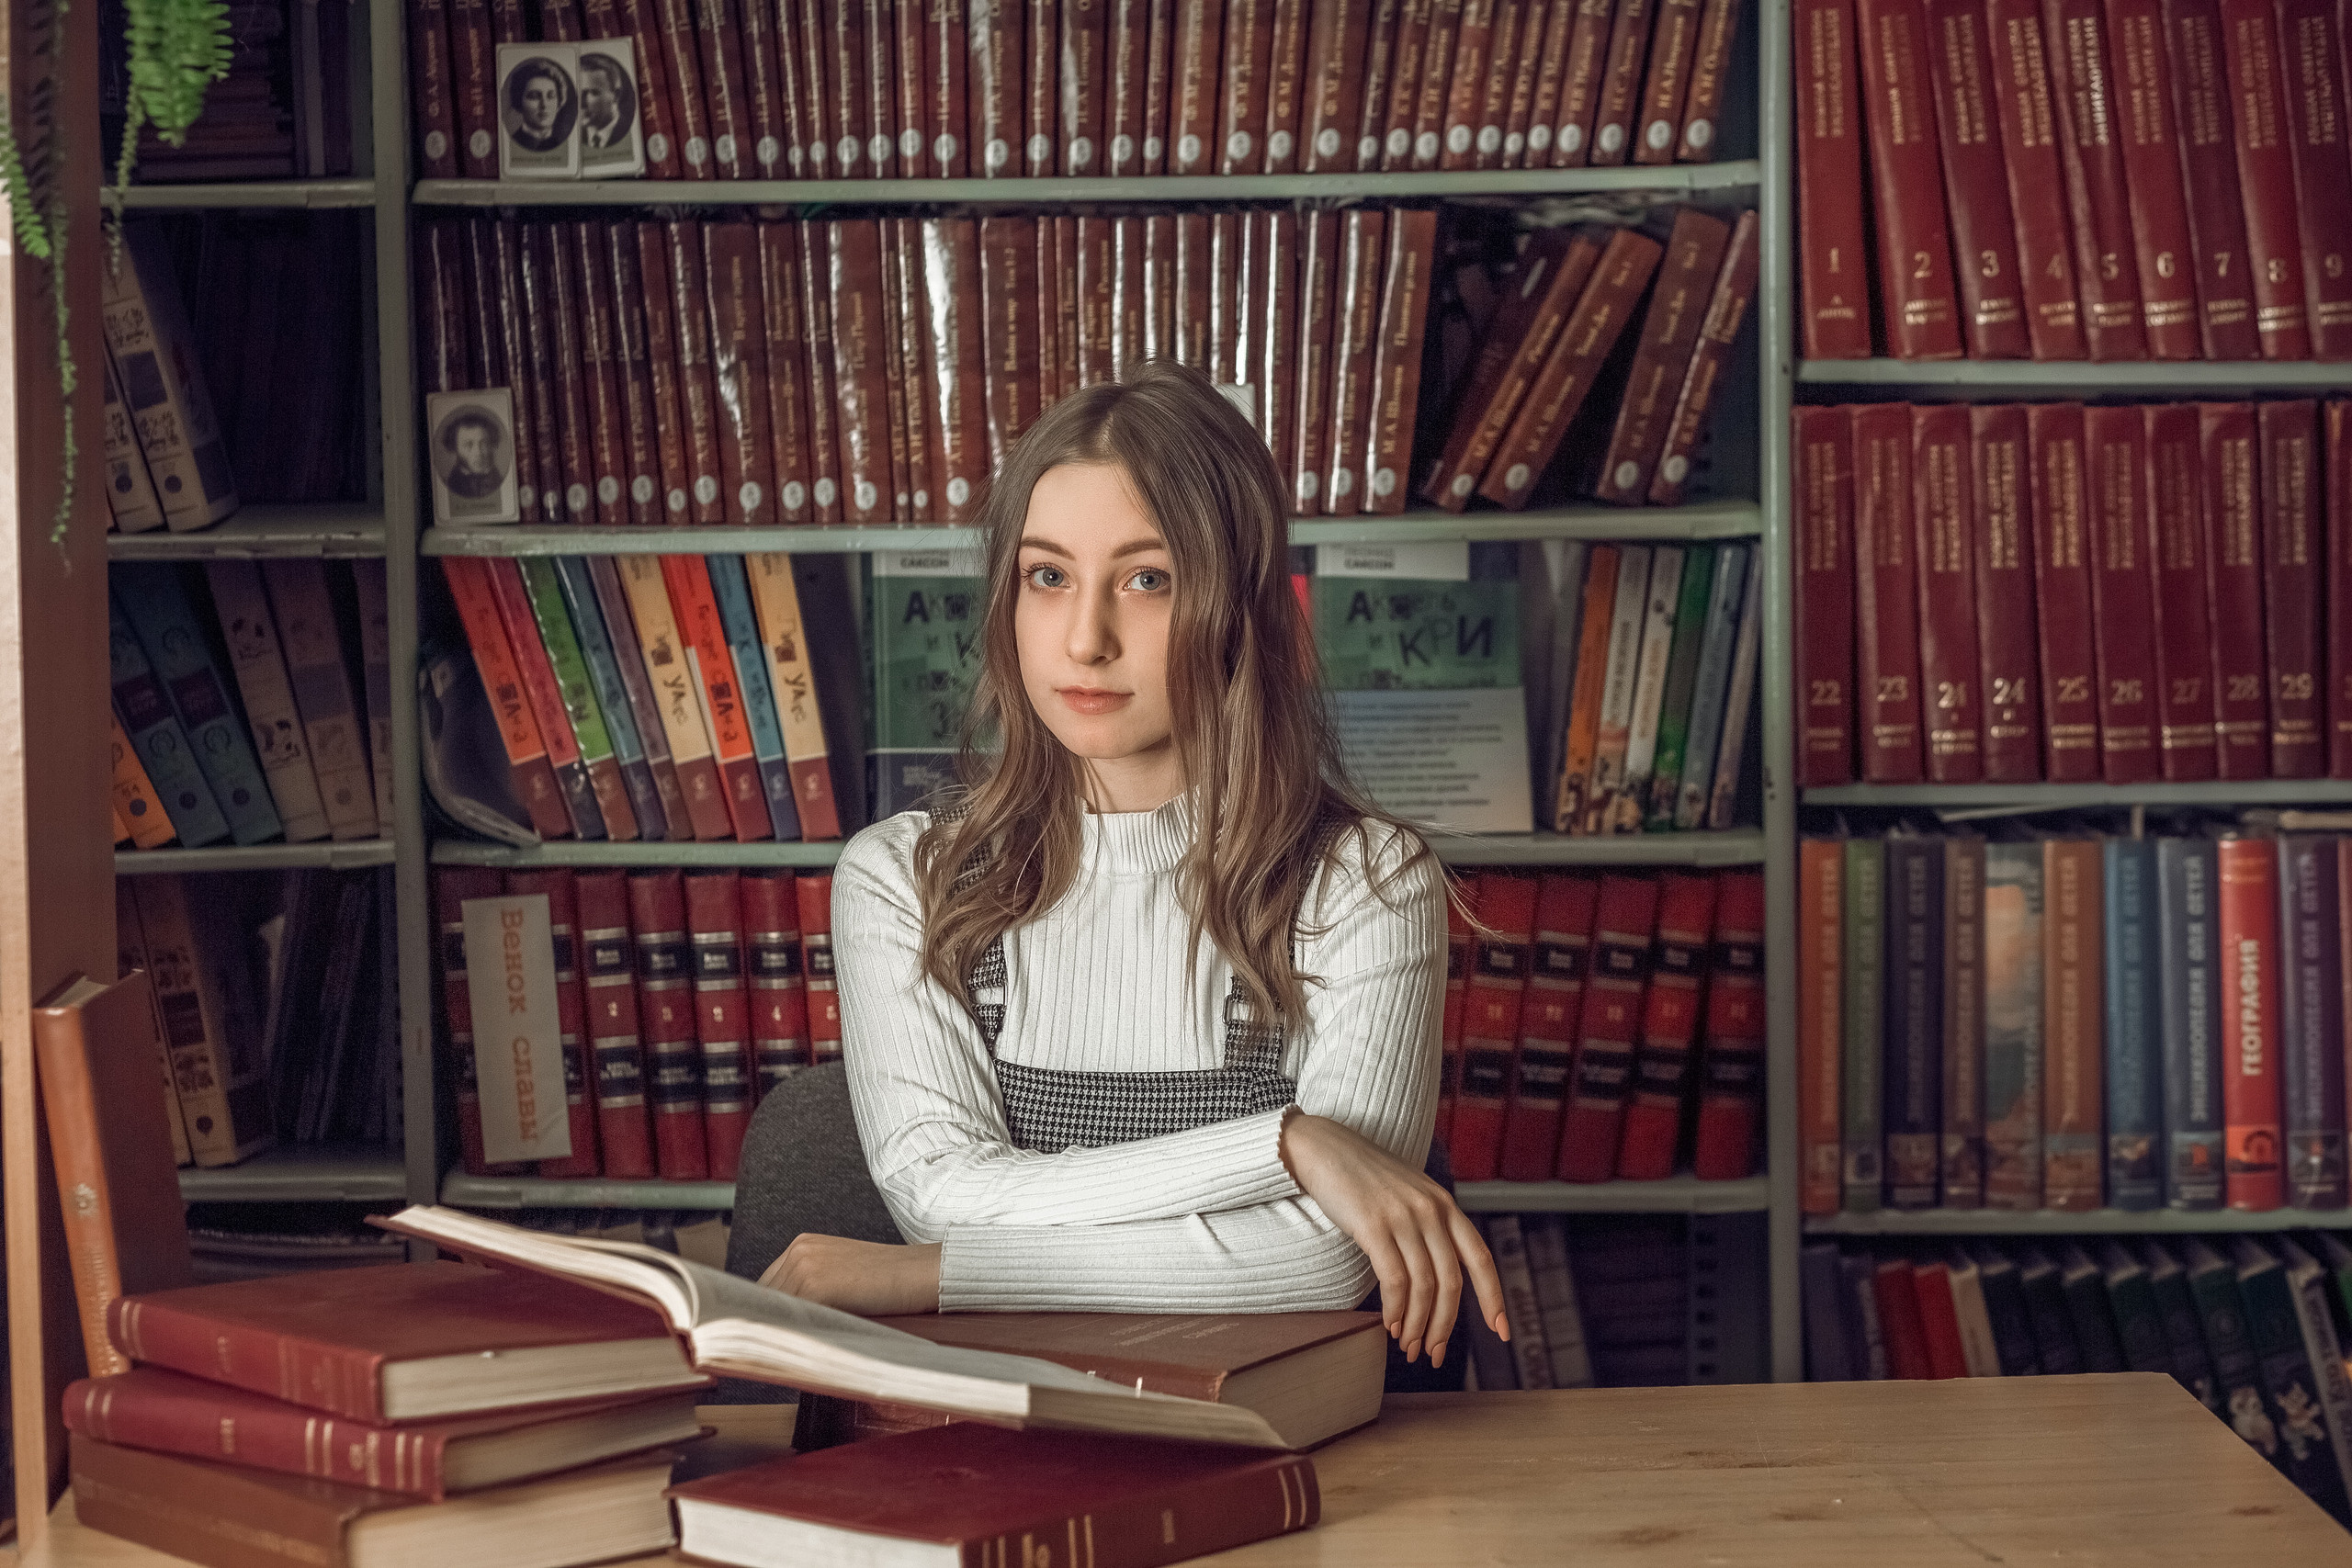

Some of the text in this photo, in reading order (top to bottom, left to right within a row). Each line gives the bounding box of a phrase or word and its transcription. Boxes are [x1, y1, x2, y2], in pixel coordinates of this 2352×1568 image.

[1914, 252, 1933, 279] 2
[1982, 250, 2000, 278] 3
[2157, 252, 2175, 278] 6
[2214, 252, 2232, 277] 7
[1811, 680, 1841, 705] 22
[1878, 677, 1908, 704] 23
[2057, 677, 2088, 704] 25
[2238, 939, 2263, 1077] ГЕОГРАФИЯ
[501, 907, 539, 1145] Венок славы
